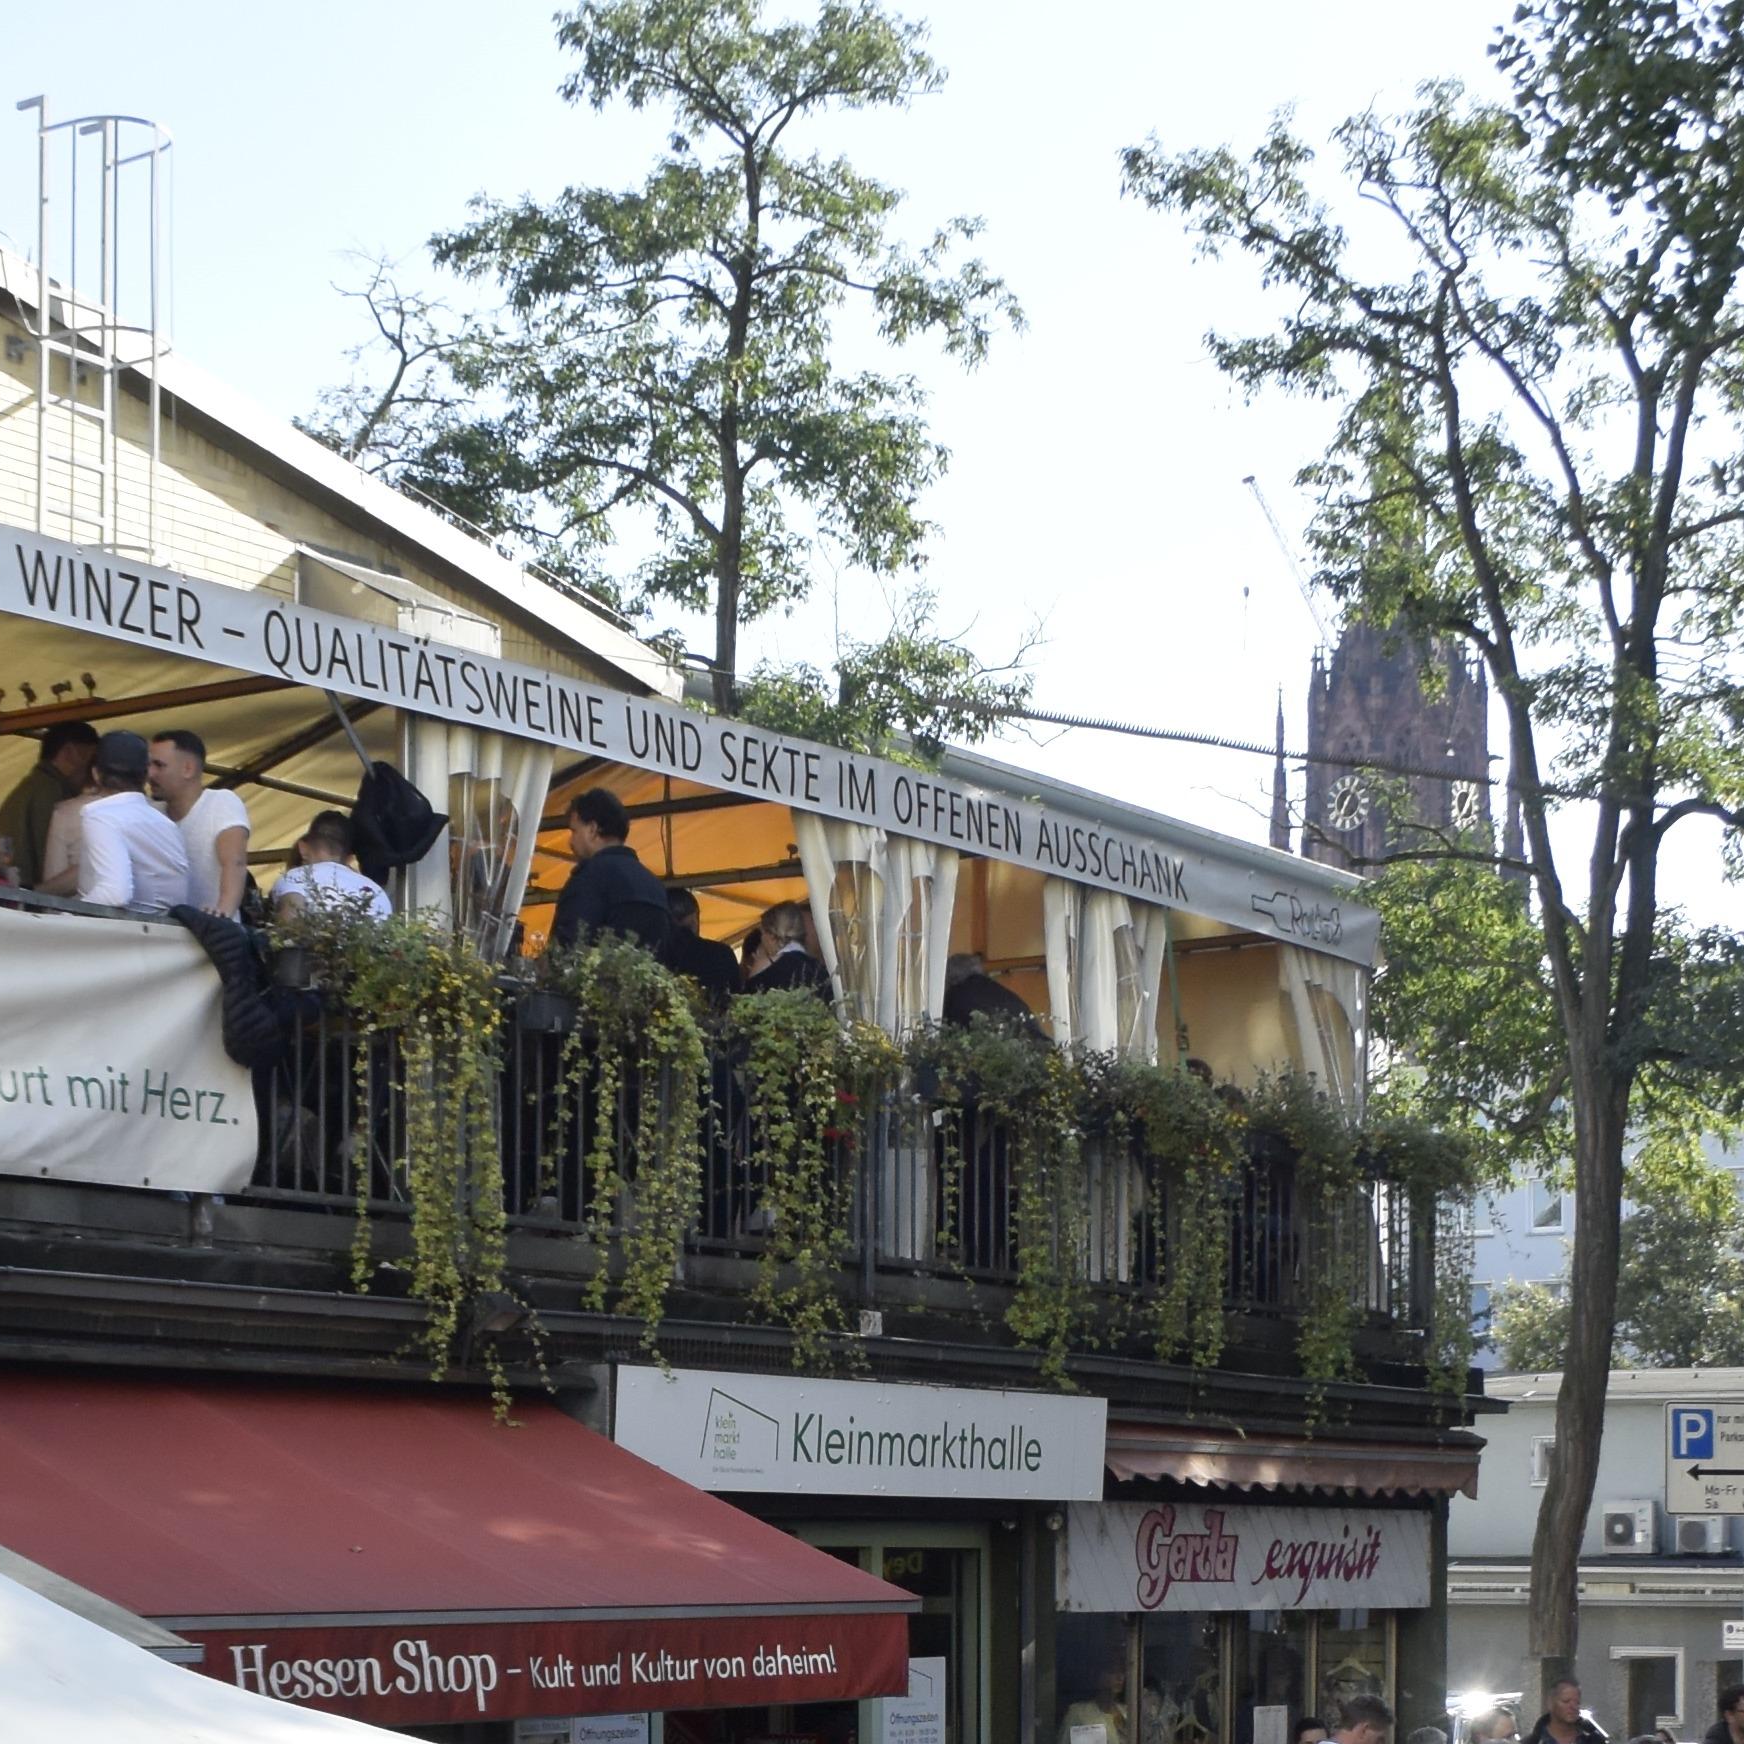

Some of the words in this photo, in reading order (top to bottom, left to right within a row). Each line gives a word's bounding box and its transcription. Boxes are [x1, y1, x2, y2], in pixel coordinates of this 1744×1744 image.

[16, 543, 205, 649] WINZER
[263, 608, 607, 750] QUALITÄTSWEINE
[626, 700, 702, 771] UND
[720, 731, 821, 803] SEKTE
[838, 760, 877, 816] IM
[893, 775, 1022, 854] OFFENEN
[1036, 820, 1189, 901] AUSSCHANK
[66, 1065, 130, 1113] mit
[140, 1067, 239, 1125] Herz.
[793, 1412, 1042, 1472] Kleinmarkthalle
[1680, 1413, 1707, 1455] P
[1135, 1504, 1239, 1609] Gerda
[1251, 1523, 1383, 1607] exquisit
[229, 1645, 394, 1701] Hessen
[394, 1639, 499, 1712] Shop
[529, 1652, 574, 1690] Kult
[582, 1653, 621, 1687] und
[631, 1649, 699, 1683] Kultur
[704, 1656, 746, 1679] von
[753, 1644, 837, 1677] daheim!
